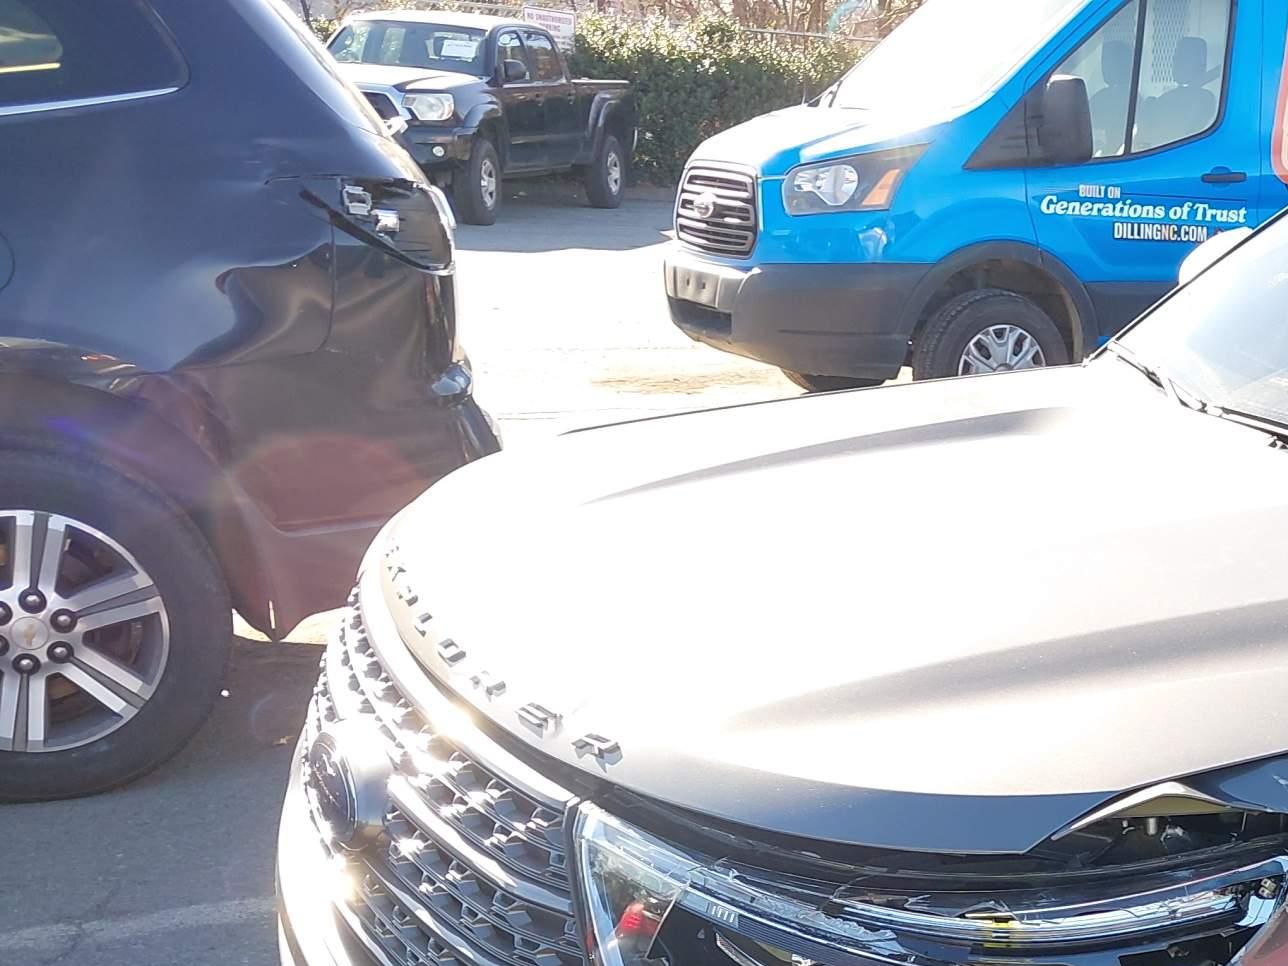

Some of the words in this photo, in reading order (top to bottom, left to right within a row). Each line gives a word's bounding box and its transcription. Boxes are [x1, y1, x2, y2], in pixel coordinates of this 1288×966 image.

[1078, 184, 1105, 199] BUILT
[1107, 186, 1121, 199] ON
[1040, 195, 1165, 219] Generations
[1169, 200, 1191, 221] of
[1193, 203, 1248, 223] Trust
[1113, 222, 1208, 243] DILLINGNC.COM
